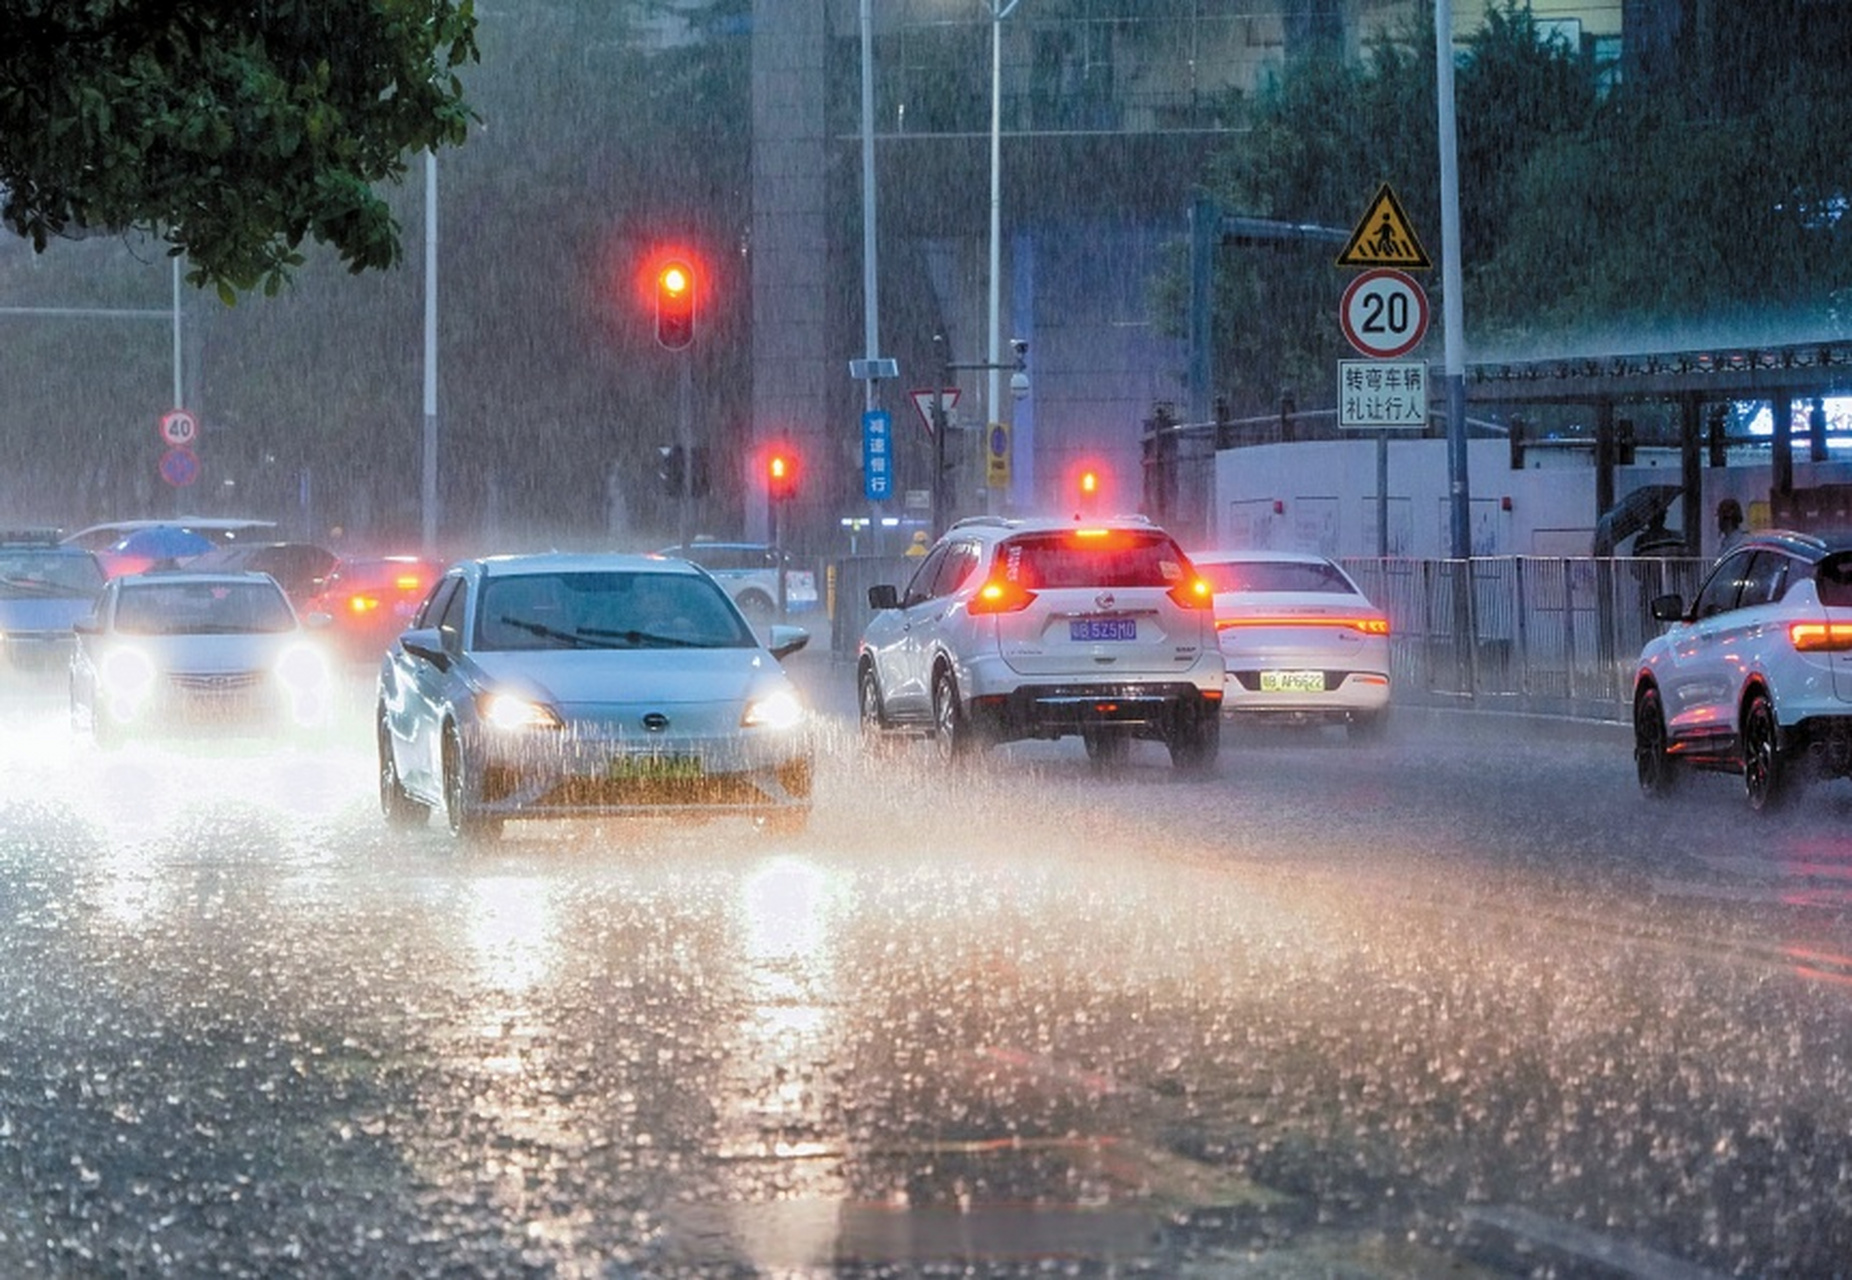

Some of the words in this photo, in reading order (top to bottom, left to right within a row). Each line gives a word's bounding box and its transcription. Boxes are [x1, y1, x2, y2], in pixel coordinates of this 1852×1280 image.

[1362, 292, 1408, 334] 20
[1346, 368, 1421, 392] 转弯车辆
[1346, 397, 1421, 421] 礼让行人
[169, 419, 190, 438] 40
